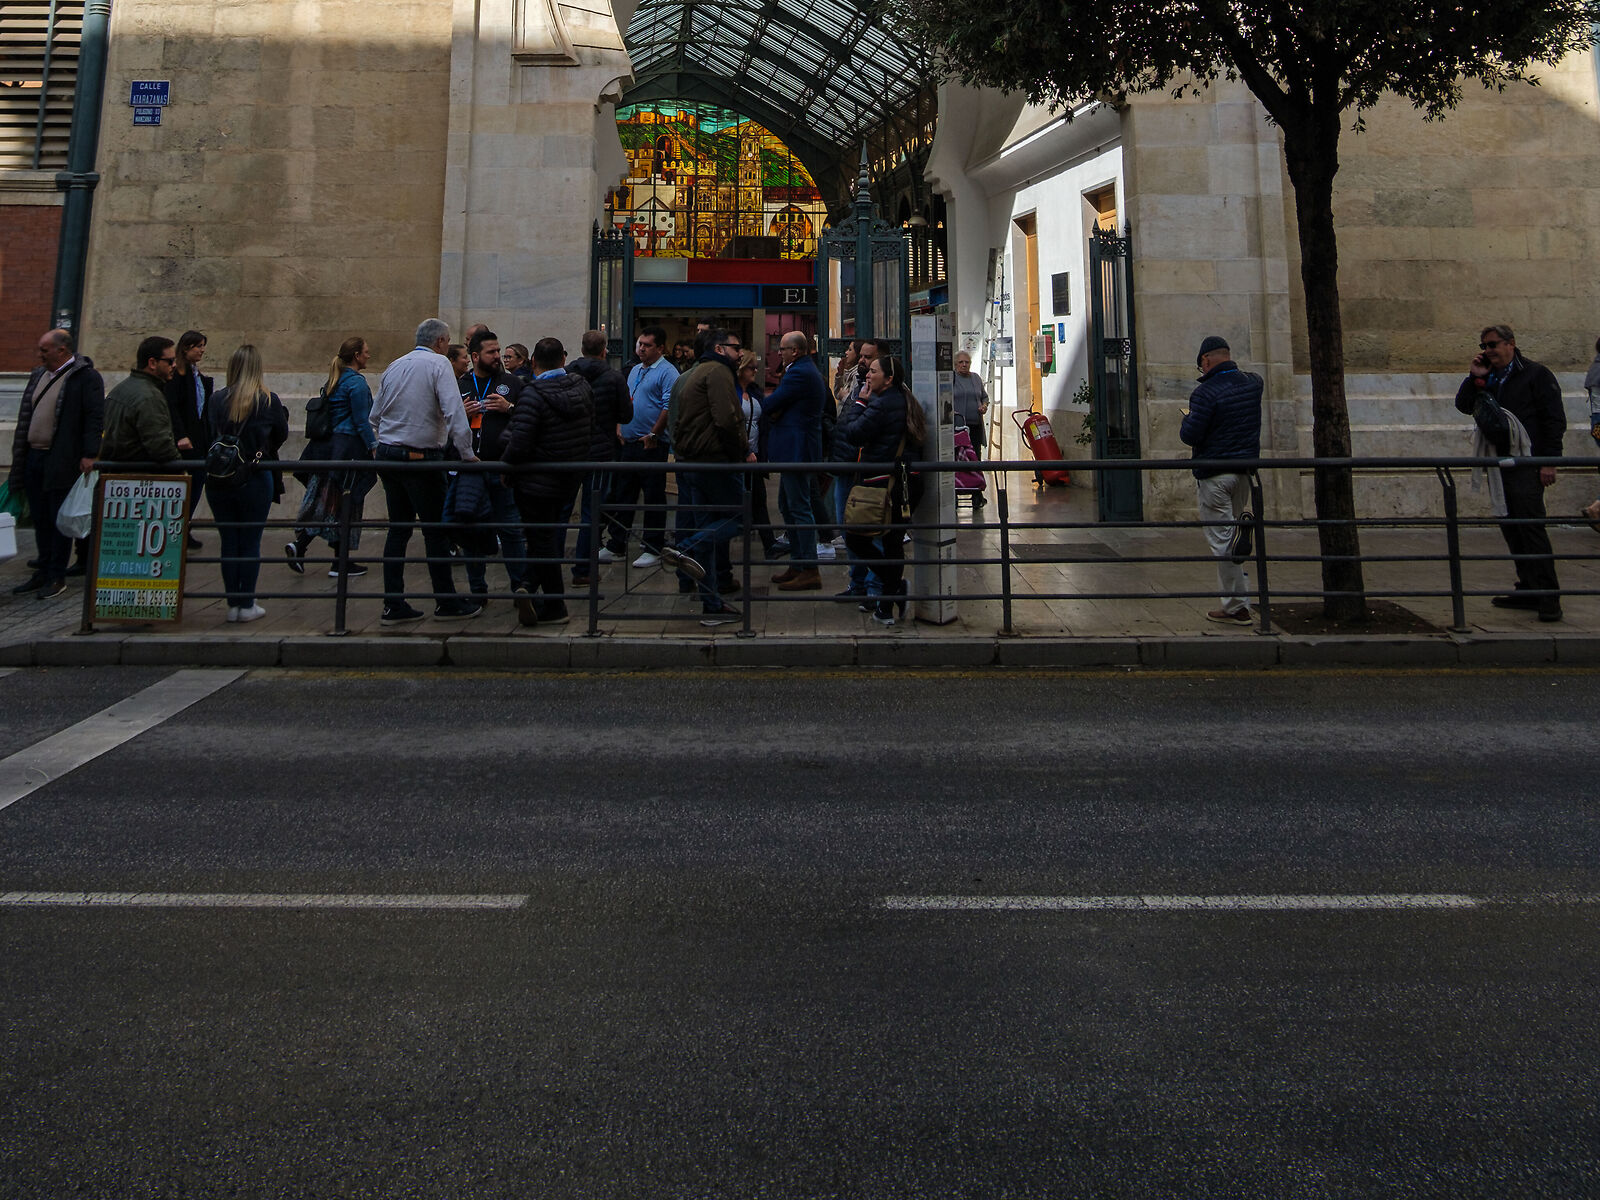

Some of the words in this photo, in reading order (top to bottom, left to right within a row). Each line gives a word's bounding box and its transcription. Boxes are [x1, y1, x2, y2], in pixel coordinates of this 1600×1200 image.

[132, 94, 167, 104] ATARAZANAS
[783, 288, 808, 304] El
[110, 486, 130, 497] LOS
[133, 487, 182, 498] PUEBLOS
[136, 520, 167, 557] 10
[168, 520, 182, 535] 50
[101, 561, 117, 573] 1/2
[151, 559, 163, 577] 8
[96, 590, 111, 605] PARA
[112, 590, 136, 605] LLEVAR
[95, 605, 162, 618] ATARAZANAS
